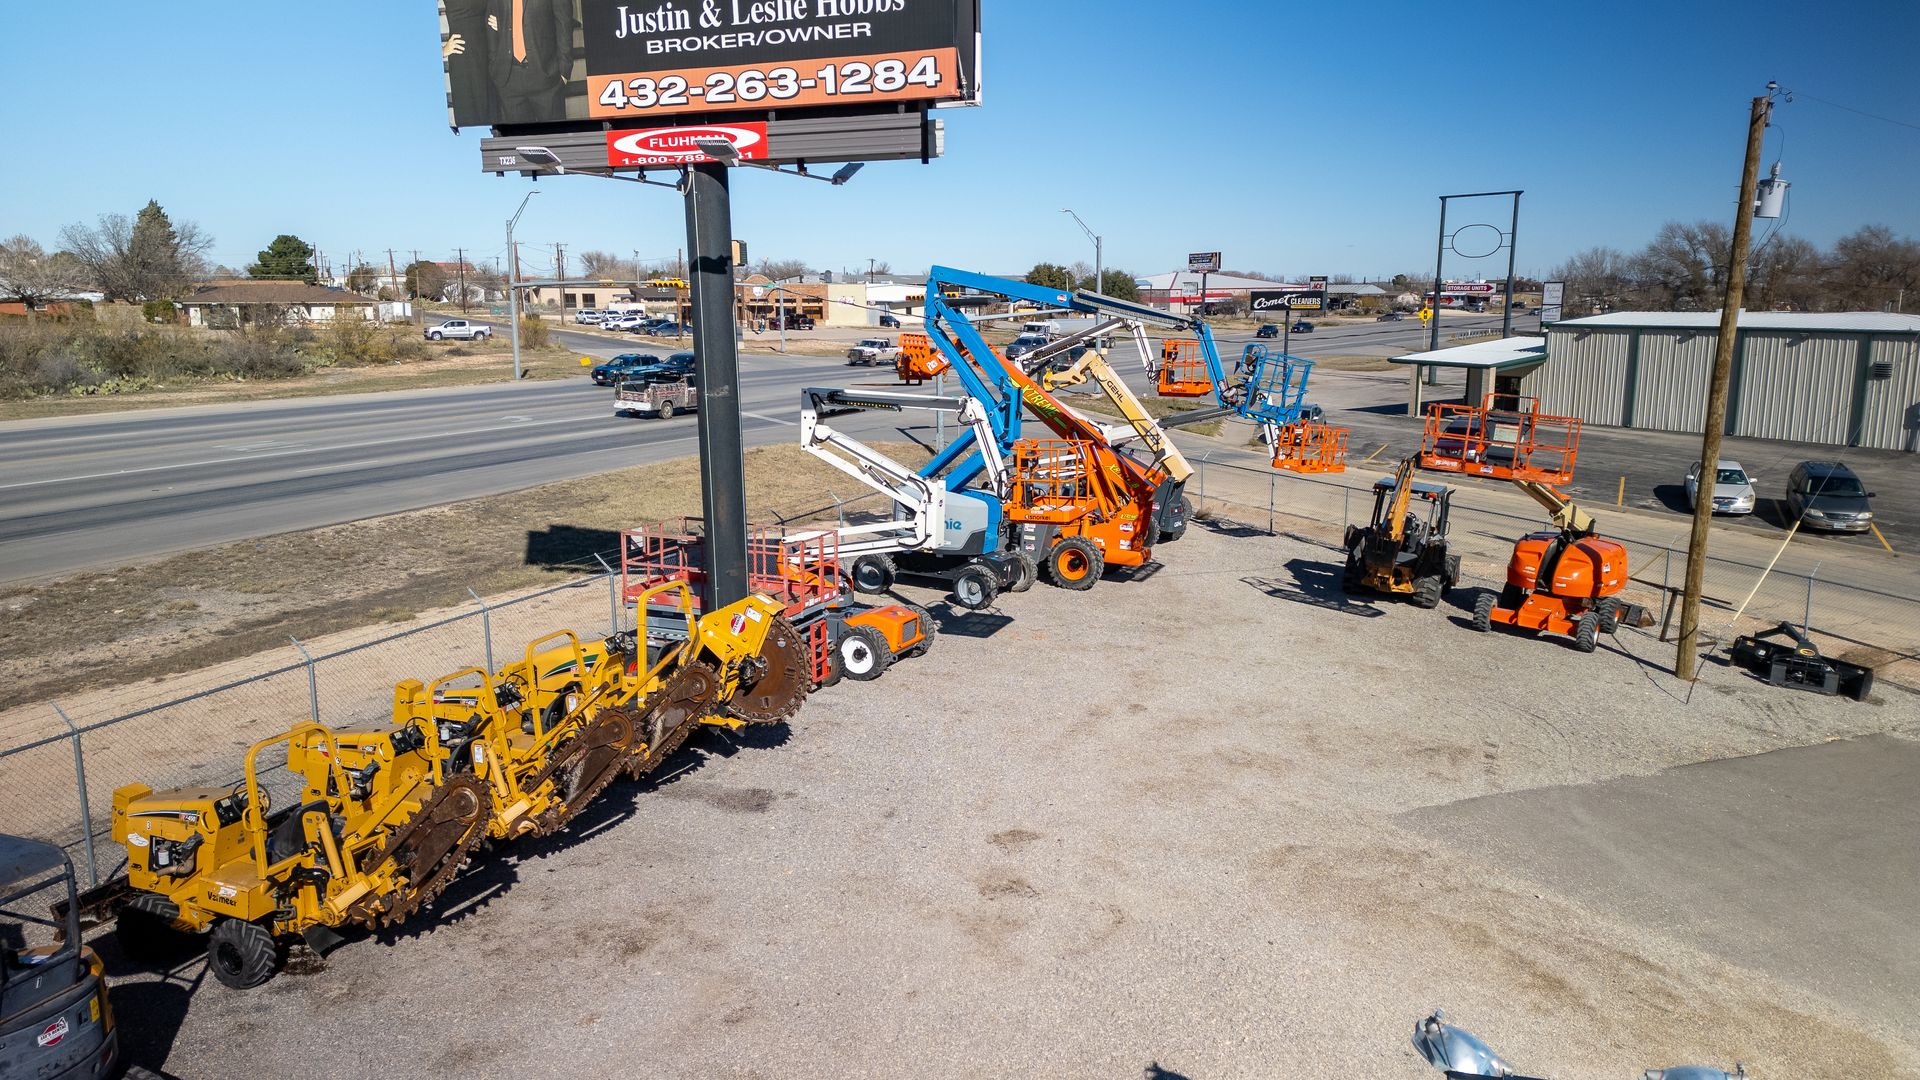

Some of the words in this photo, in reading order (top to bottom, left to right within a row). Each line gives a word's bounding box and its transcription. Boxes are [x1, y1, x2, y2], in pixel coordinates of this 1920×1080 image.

[615, 1, 691, 39] Justin
[699, 0, 722, 29] &
[731, 0, 808, 26] Leslie
[646, 22, 872, 54] BROKER/OWNER
[599, 55, 941, 109] 432-263-1284
[649, 134, 725, 148] FLUH
[1253, 293, 1302, 309] Comet
[1290, 297, 1321, 305] CLEANERS
[1106, 380, 1124, 403] GEHL
[944, 518, 962, 530] nie
[627, 595, 657, 603] SKYCK
[207, 891, 237, 907] Vermeer
